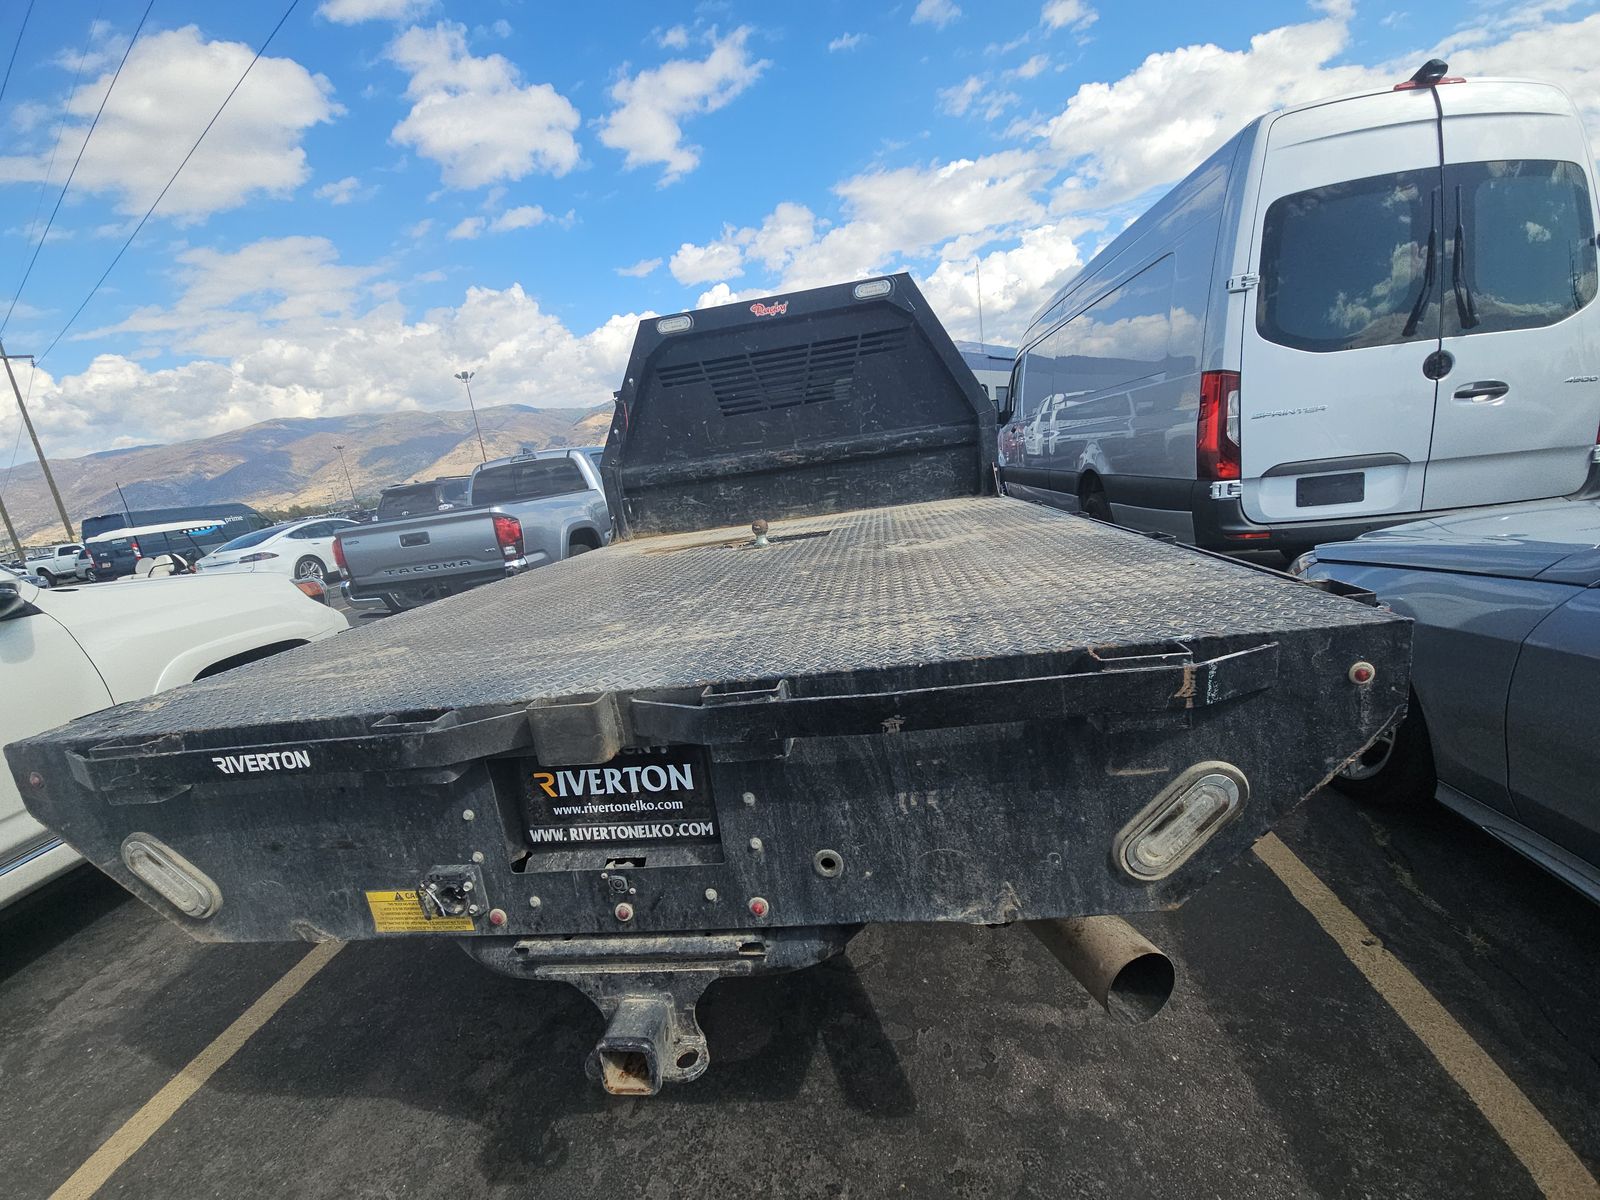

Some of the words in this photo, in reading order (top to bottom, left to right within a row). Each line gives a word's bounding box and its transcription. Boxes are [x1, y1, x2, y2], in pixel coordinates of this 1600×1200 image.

[384, 559, 472, 576] TACOMA
[211, 750, 311, 774] RIVERTON
[533, 763, 694, 798] RIVERTON
[553, 800, 683, 816] www.rivertonelko.com
